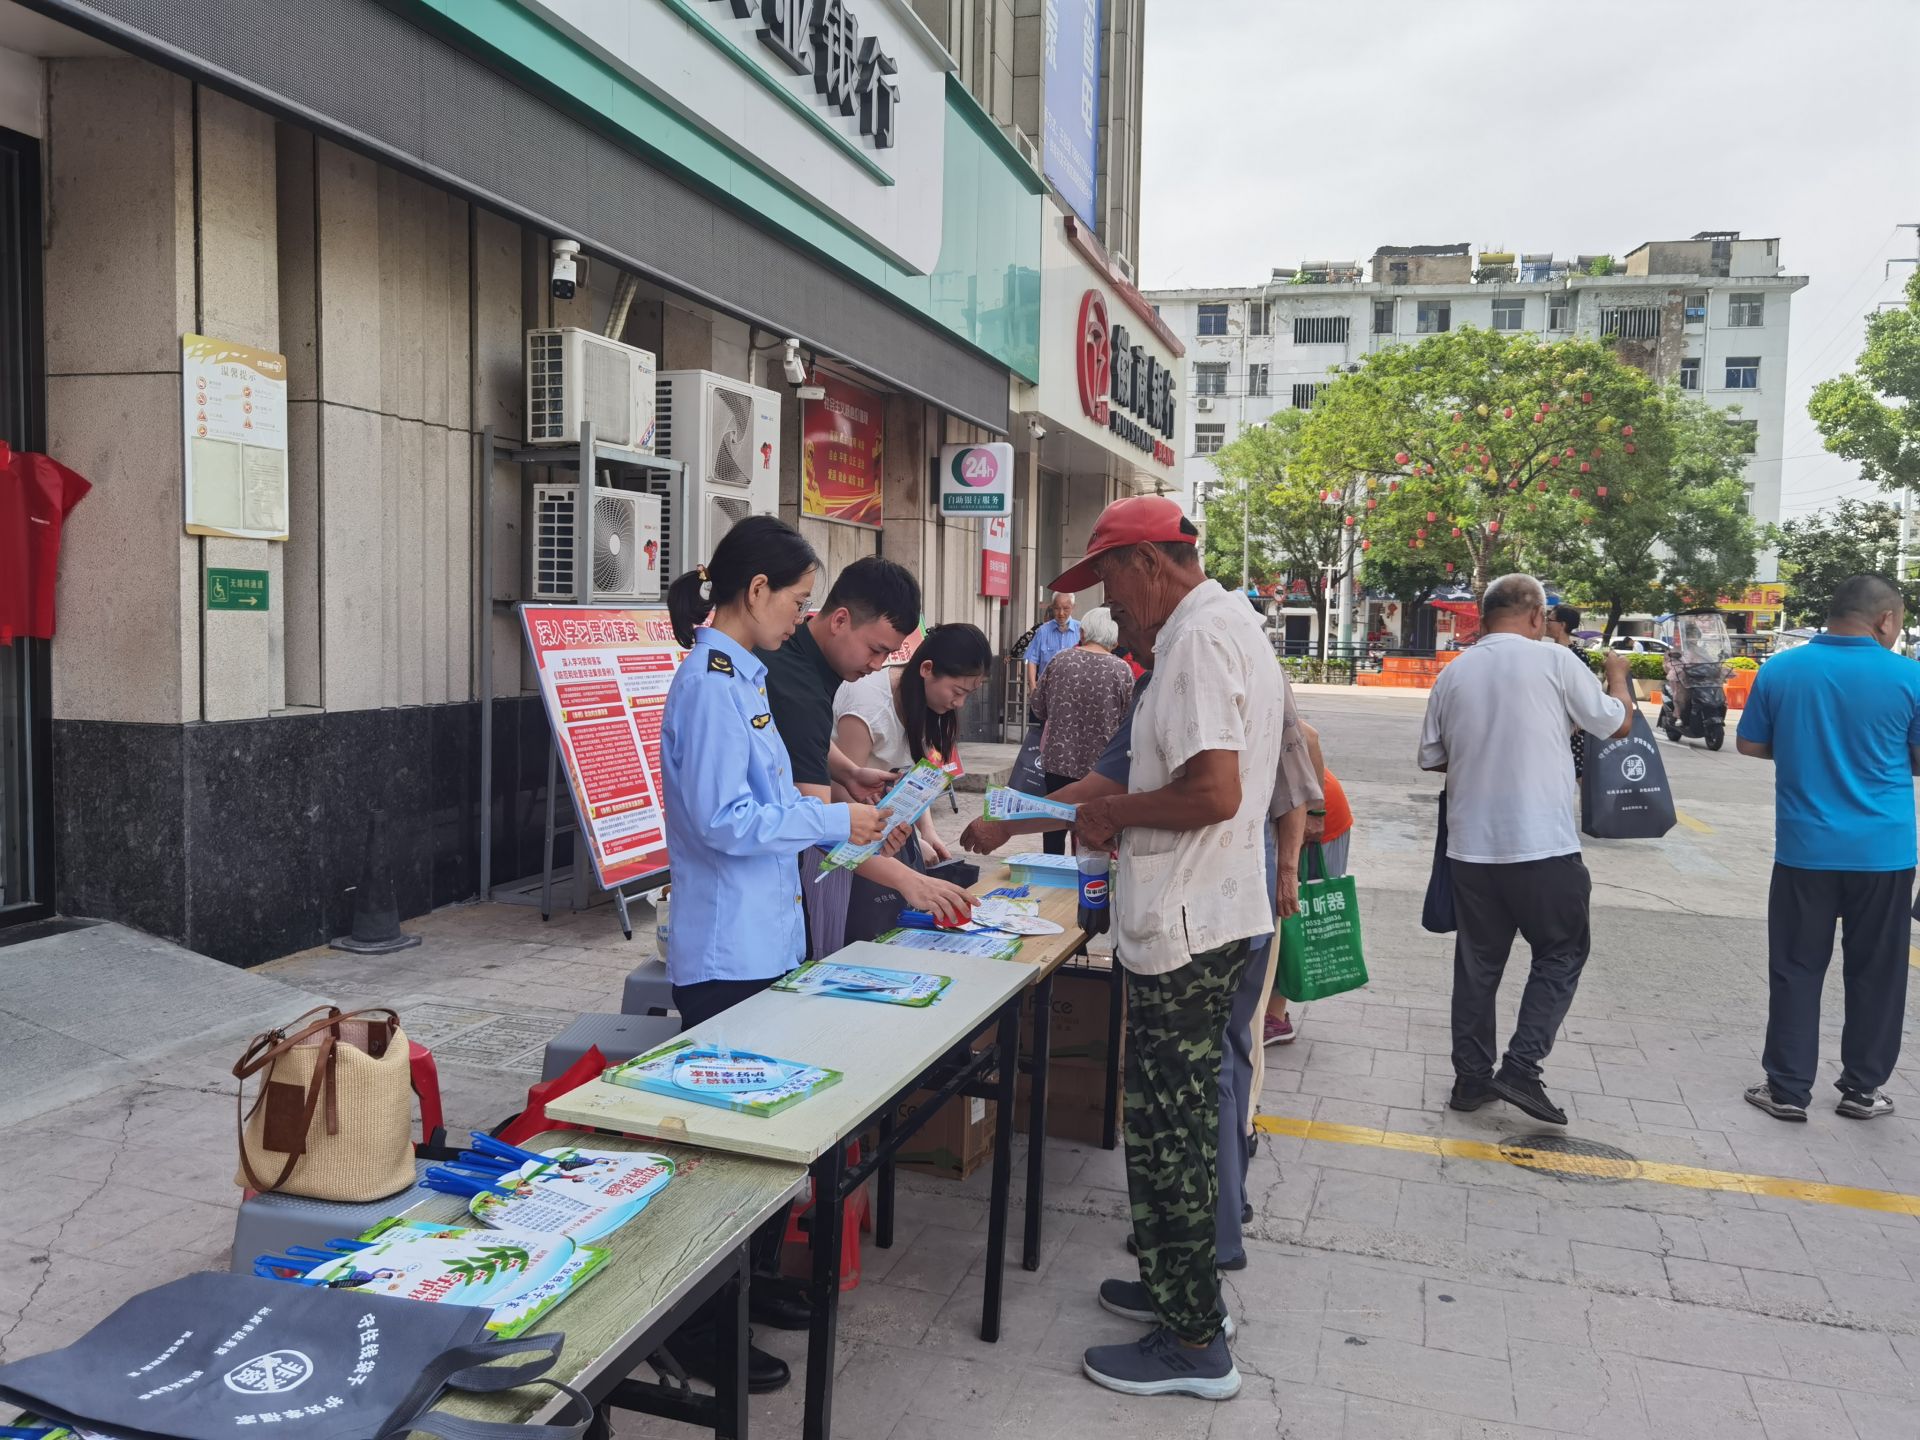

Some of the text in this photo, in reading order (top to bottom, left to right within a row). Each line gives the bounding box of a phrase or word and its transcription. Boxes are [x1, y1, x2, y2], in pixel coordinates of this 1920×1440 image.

[1153, 440, 1175, 466] BANK
[965, 456, 994, 478] 24h
[948, 495, 999, 505] 自助银行服务
[535, 619, 640, 646] 深入学习贯彻落实
[213, 1305, 273, 1356] 远离非法集资
[347, 1312, 380, 1387] 守住钱袋子
[234, 1395, 344, 1426] 护好幸福家
